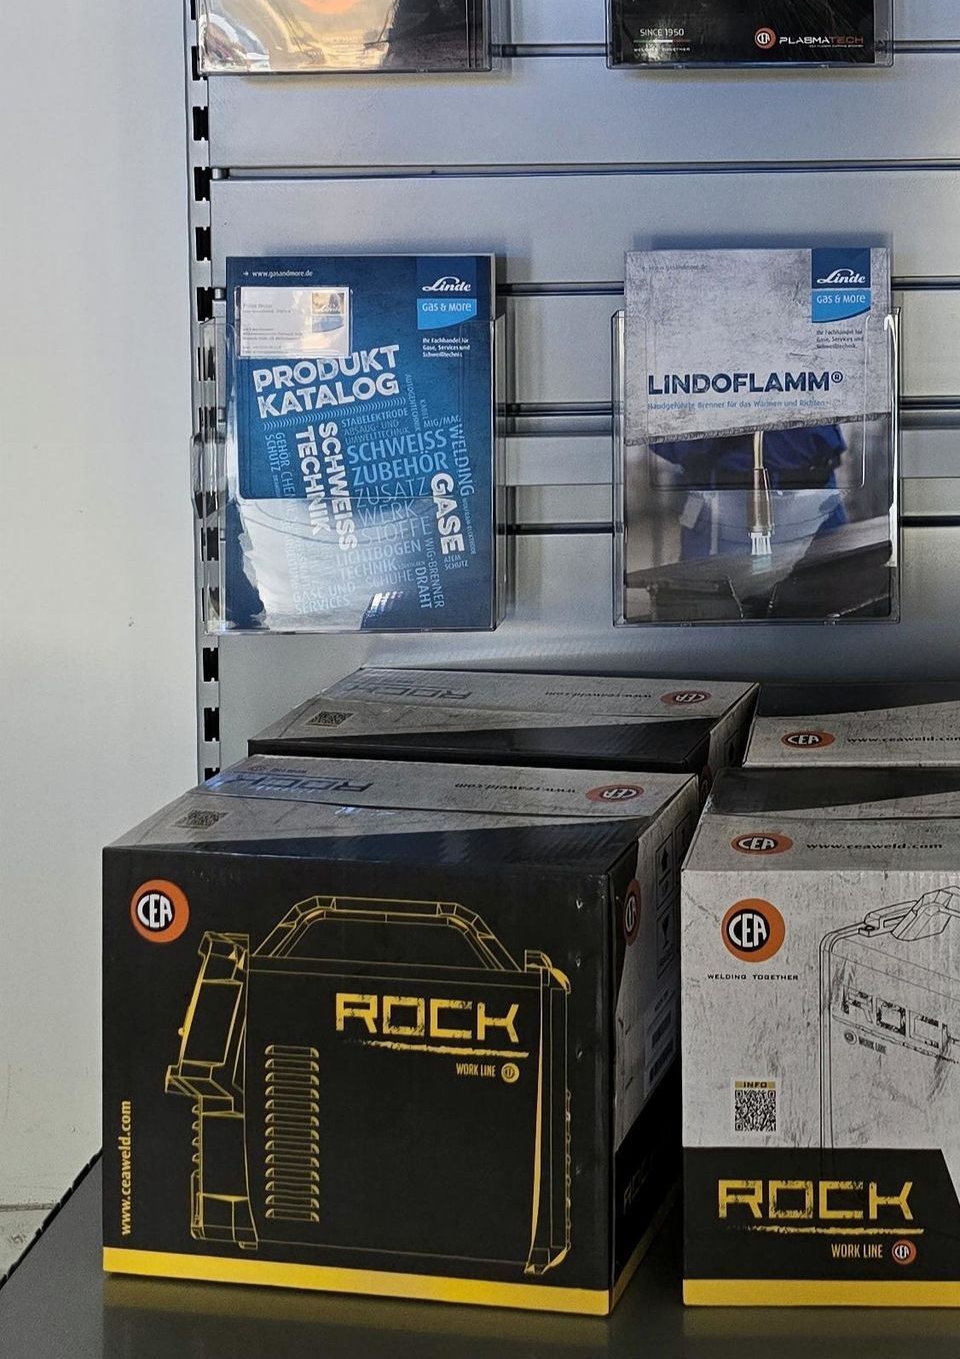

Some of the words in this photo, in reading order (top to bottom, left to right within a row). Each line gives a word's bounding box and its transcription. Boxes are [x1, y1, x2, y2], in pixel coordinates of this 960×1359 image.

[640, 28, 663, 37] SINCE
[665, 28, 685, 37] 1950
[779, 36, 864, 45] PLASMATECH
[252, 270, 313, 278] www.gasandmore.de
[422, 277, 472, 291] Linde
[817, 268, 866, 284] Linde
[421, 302, 438, 312] Gas
[440, 303, 447, 311] &
[448, 302, 471, 312] More
[816, 294, 833, 304] Gas
[834, 295, 841, 303] &
[842, 294, 866, 304] More
[253, 344, 399, 392] PRODUKT
[257, 372, 400, 419] KATALOG
[697, 401, 725, 409] Brenner
[727, 400, 738, 408] für
[739, 400, 751, 408] das
[783, 399, 797, 407] und
[341, 408, 409, 428] STABELEKTRODE
[381, 419, 399, 430] UND
[264, 435, 281, 472] SCHUTZ
[346, 428, 447, 464] SCHWEISS
[351, 451, 449, 486] ZUBEHÖR
[448, 423, 475, 497] WELDING
[295, 425, 331, 536] TECHNIK
[318, 421, 358, 550] SCHWEISS
[354, 477, 430, 508] ZUSATZ
[357, 499, 418, 527] WERK
[431, 473, 465, 555] GASE
[360, 516, 433, 547] STOFFE
[335, 539, 422, 567] LICHTBOGEN
[340, 559, 399, 581] TECHNIK
[365, 569, 415, 588] SCHUHE
[424, 537, 445, 609] WIG-BRENNER
[328, 581, 356, 595] UND
[414, 566, 433, 609] DRAHT
[786, 734, 821, 746] CEA
[455, 781, 577, 794] www.ceaweld.com
[602, 787, 638, 800] CEA
[737, 837, 776, 851] CEA
[806, 841, 944, 850] www.ceaweld.com
[136, 893, 173, 929] CEA
[728, 913, 768, 948] CEA
[752, 973, 799, 981] TOGETHER
[335, 992, 520, 1043] ROCK
[455, 1062, 479, 1076] WORK
[480, 1063, 496, 1077] LINE
[743, 1081, 768, 1089] INFO
[118, 1100, 131, 1236] www.ceaweld.com
[718, 1179, 914, 1221] ROCK
[831, 1243, 861, 1259] WORK
[863, 1243, 883, 1258] LINE
